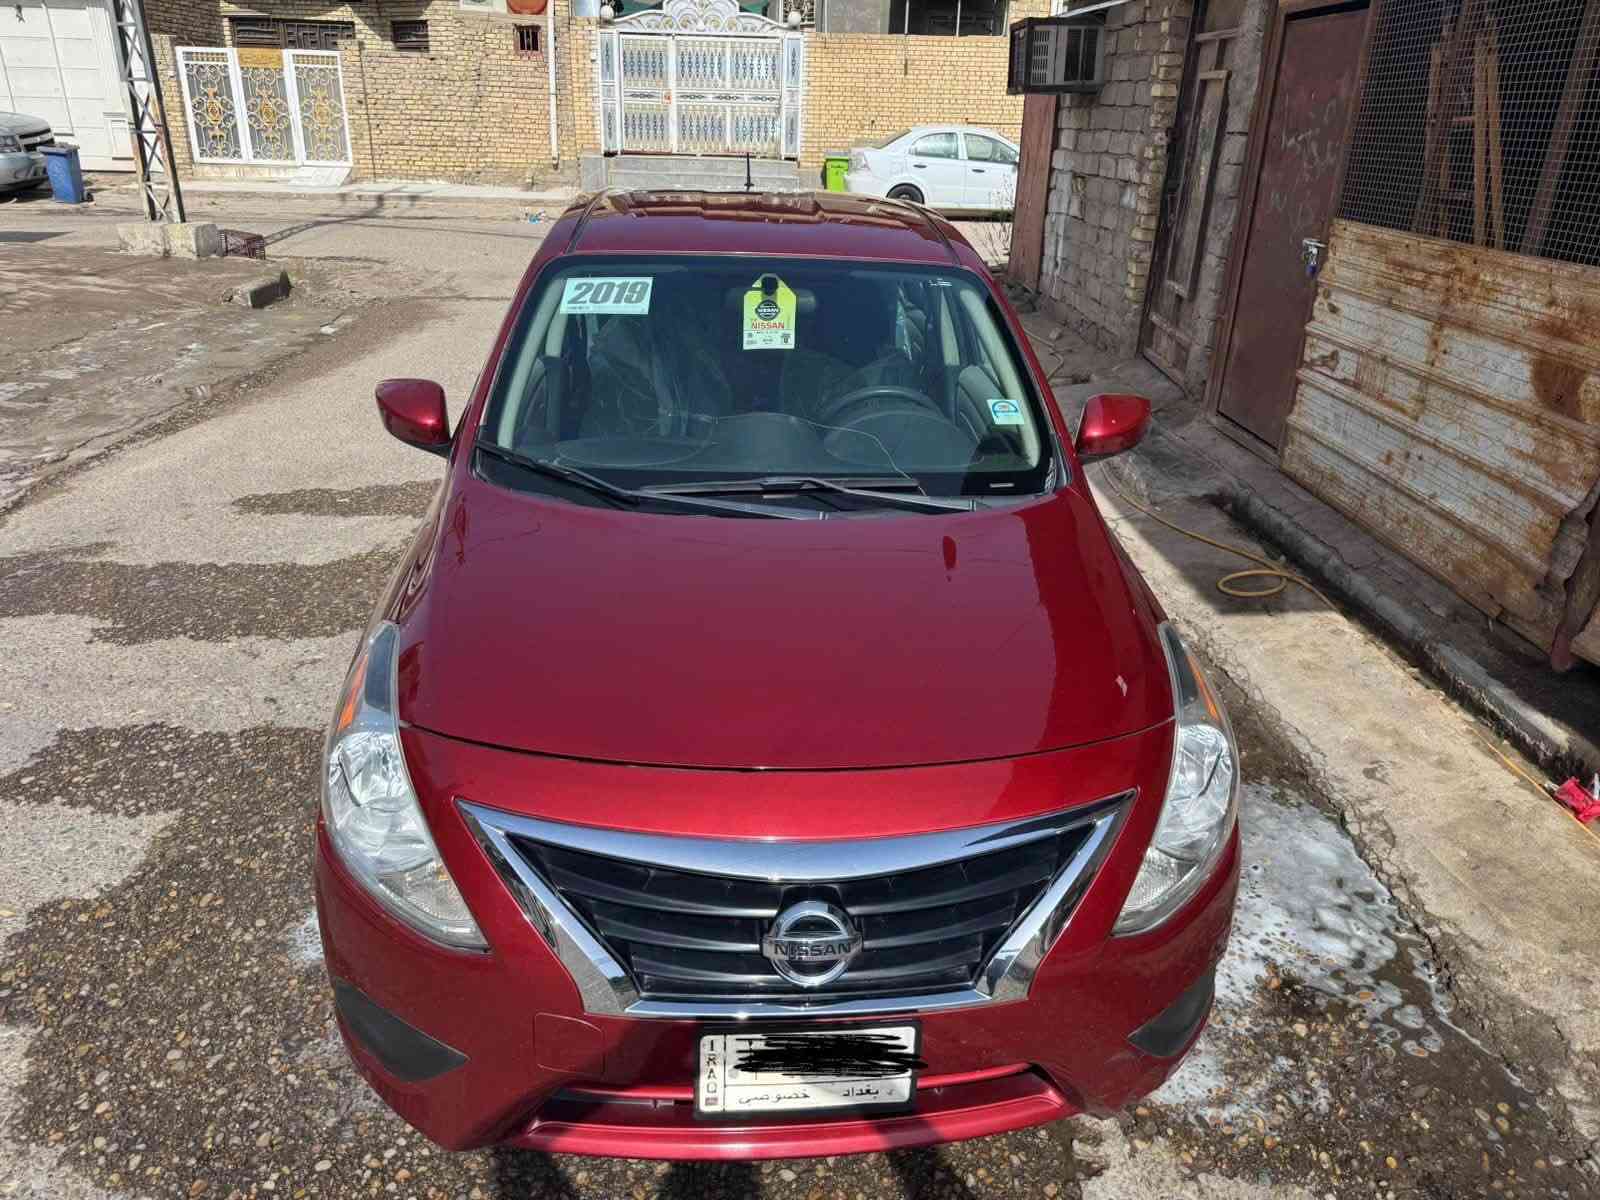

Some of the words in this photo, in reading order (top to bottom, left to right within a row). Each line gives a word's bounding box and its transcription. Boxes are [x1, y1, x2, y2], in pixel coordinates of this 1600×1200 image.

[567, 281, 650, 304] 2019
[752, 321, 785, 329] NISSAN
[774, 942, 851, 956] NISSAN
[706, 1039, 718, 1094] IRAQ
[842, 1084, 879, 1099] بغداد
